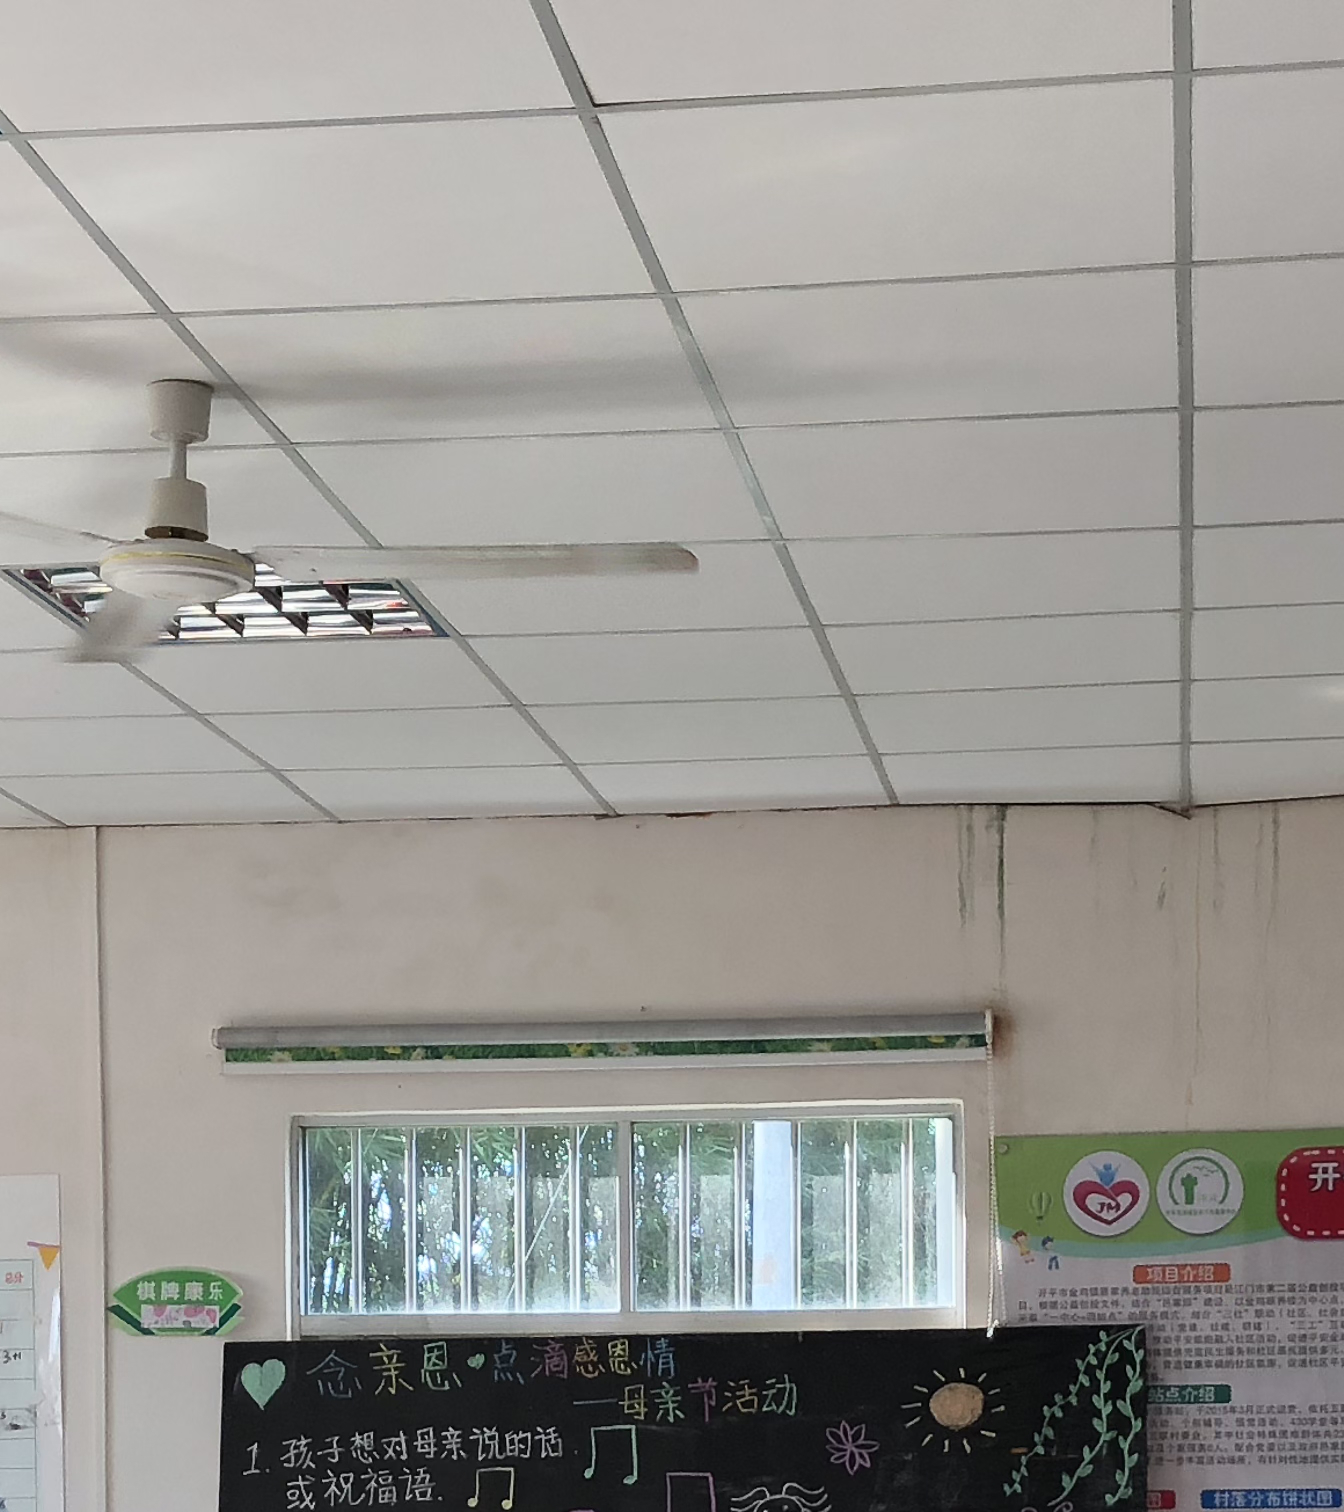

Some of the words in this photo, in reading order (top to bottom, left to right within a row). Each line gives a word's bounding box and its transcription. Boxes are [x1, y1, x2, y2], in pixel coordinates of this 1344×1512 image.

[1146, 1267, 1214, 1282] 项目介绍
[136, 1281, 223, 1301] 棋牌康乐
[306, 1341, 462, 1399] 念亲恩
[492, 1338, 675, 1386] 点滴感恩情
[1147, 1386, 1215, 1401] 站点介绍
[1213, 1491, 1332, 1507] 村落分布饼状图
